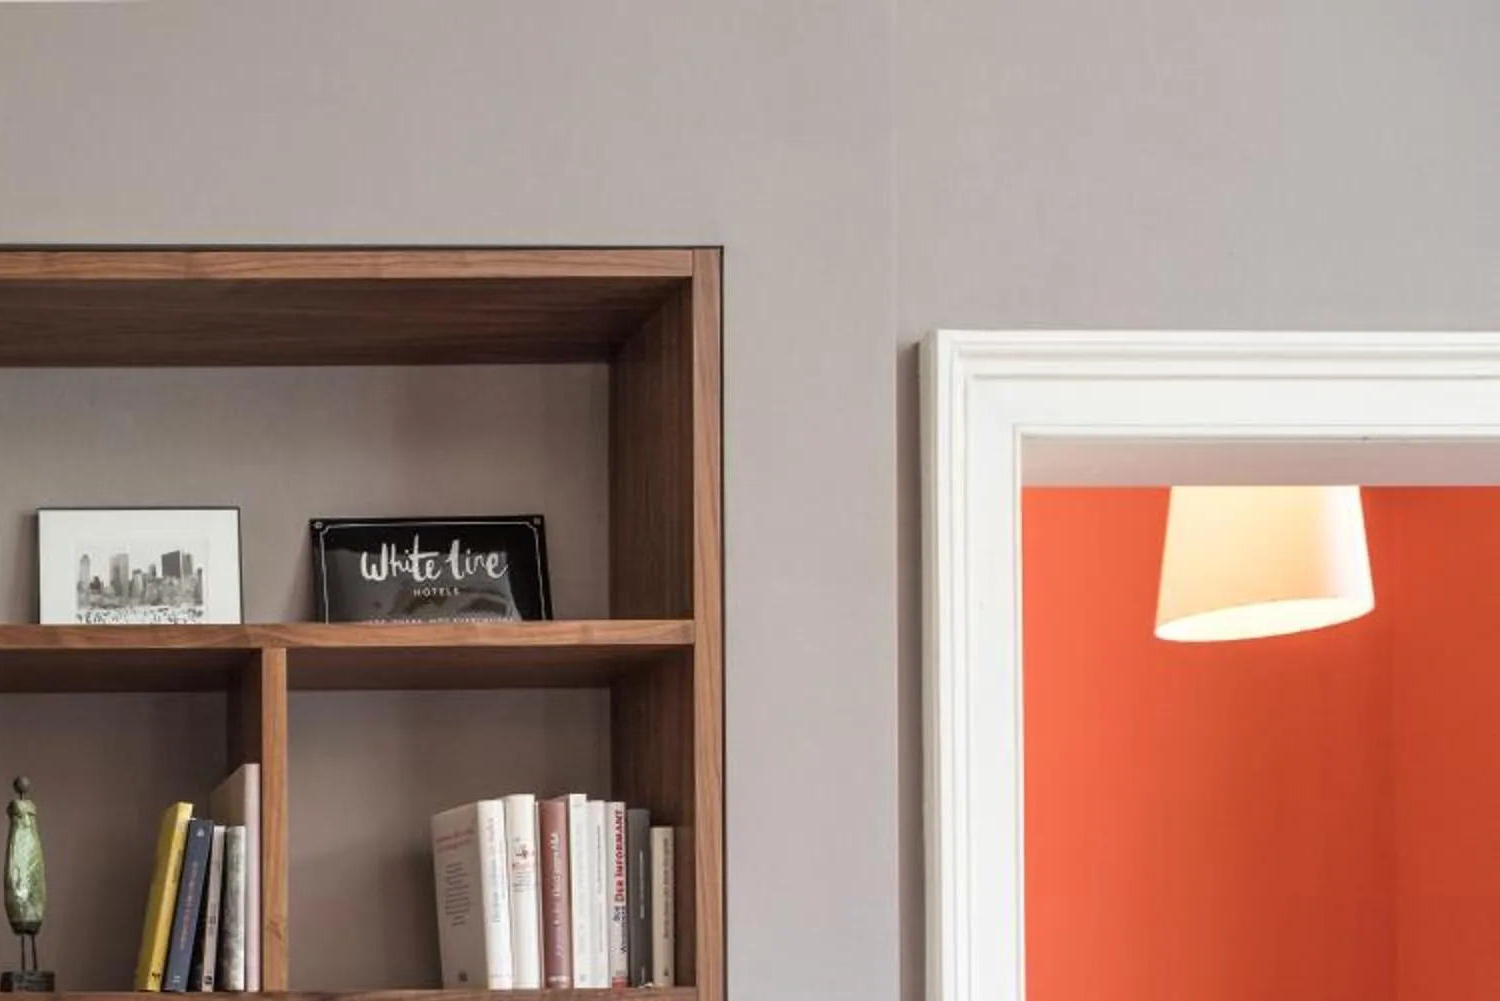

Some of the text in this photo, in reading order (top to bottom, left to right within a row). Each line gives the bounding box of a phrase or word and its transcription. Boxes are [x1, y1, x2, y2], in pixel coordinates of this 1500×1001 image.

[360, 533, 509, 582] White line
[413, 587, 460, 598] HOTELS
